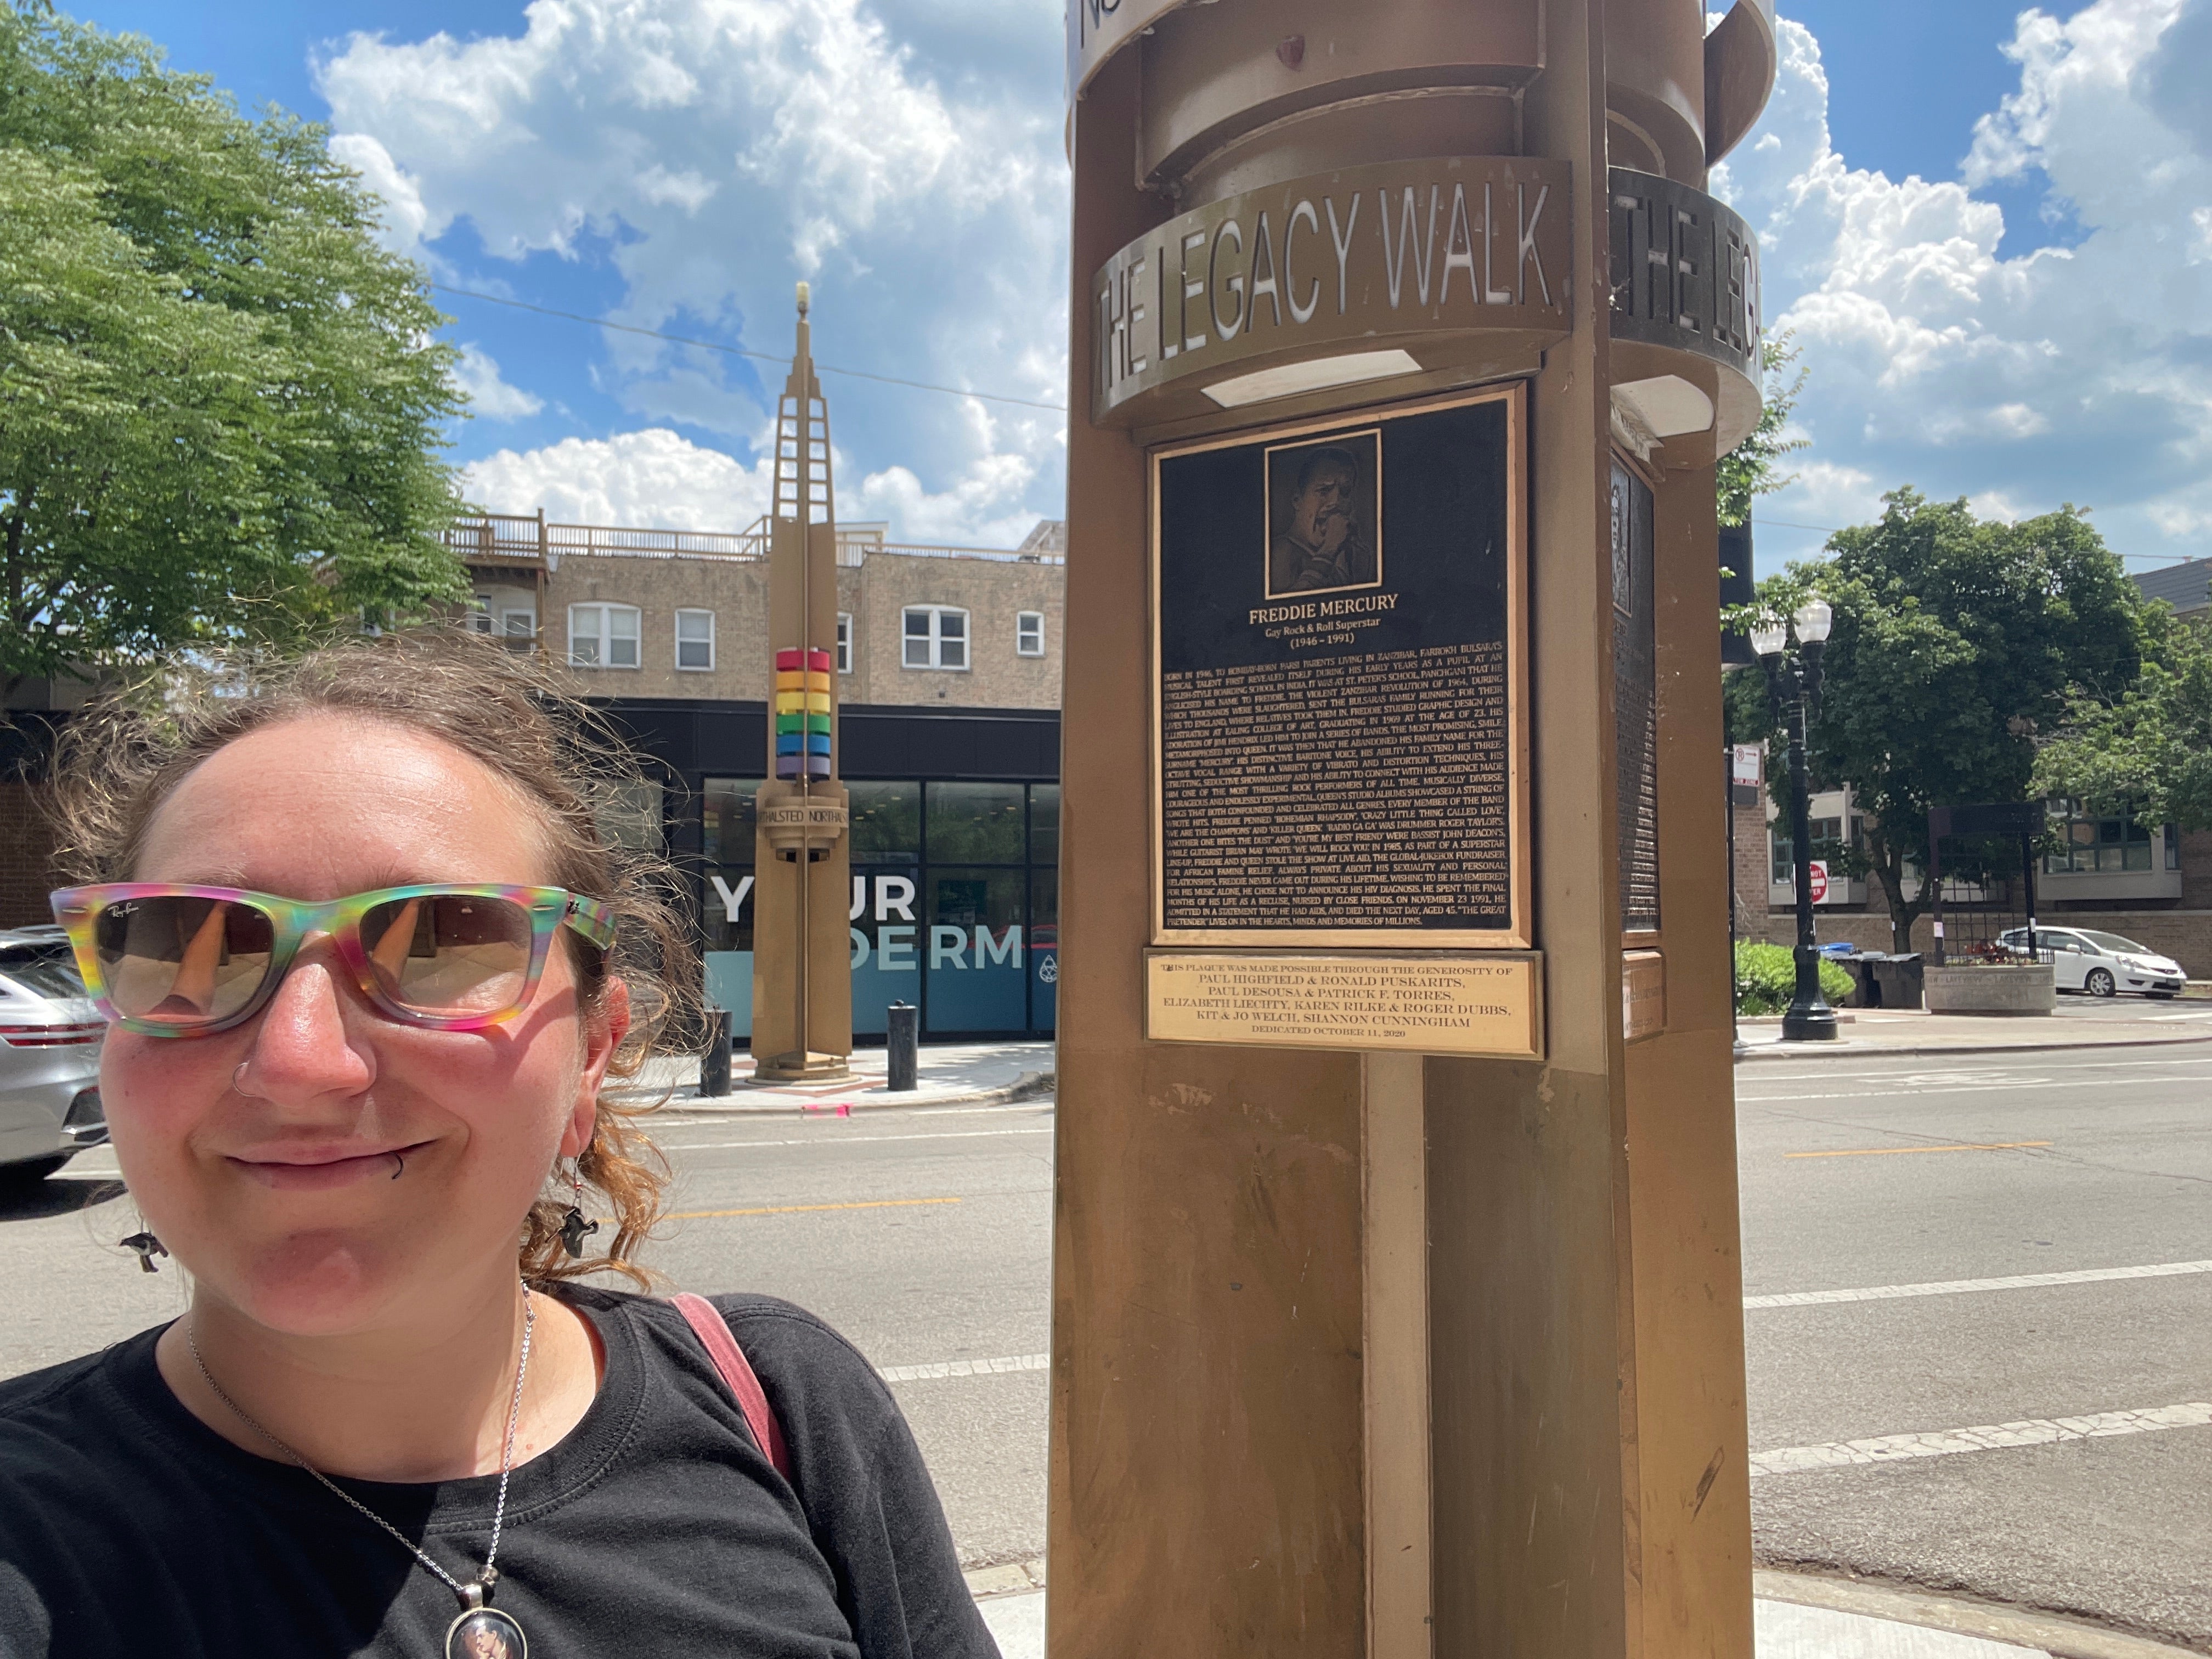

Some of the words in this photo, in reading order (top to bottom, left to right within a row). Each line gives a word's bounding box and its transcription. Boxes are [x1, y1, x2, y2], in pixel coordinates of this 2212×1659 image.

[1615, 195, 1700, 334] THE
[1098, 257, 1147, 394] THE
[1159, 190, 1359, 360] LEGACY
[1379, 180, 1553, 309] WALK
[1249, 603, 1316, 624] FREDDIE
[1321, 593, 1398, 617] MERCURY
[1265, 628, 1282, 639] Gay
[1284, 624, 1305, 635] Rock
[1307, 624, 1314, 633] &
[1317, 622, 1334, 632] Roll
[1336, 618, 1381, 630] Superstar
[1290, 636, 1317, 650] (1946
[1327, 632, 1355, 645] 1991)
[1345, 864, 1371, 872] ABOUT
[1440, 862, 1458, 871] AND
[1464, 884, 1480, 892] THE
[1396, 895, 1407, 904] ON
[1411, 895, 1453, 903] NOVEMBER
[1457, 895, 1466, 903] 23
[1494, 894, 1505, 902] HE
[1417, 967, 1493, 975] GENEROSITY
[1199, 974, 1231, 984] PAUL
[1233, 975, 1304, 984] HIGHFIELD
[1307, 976, 1317, 985] &
[1321, 976, 1376, 986] RONALD
[1381, 977, 1465, 988] PUSKARITS,
[1209, 986, 1239, 996] PAUL
[1243, 987, 1301, 997] DESOUSA
[1305, 988, 1314, 997] &
[1318, 988, 1375, 998] PATRICK
[1380, 990, 1389, 999] F.
[1393, 990, 1455, 1001] TORRES,
[1164, 997, 1230, 1008] ELIZABETH
[1233, 999, 1290, 1011] LIECHTY,
[1294, 1000, 1339, 1011] KAREN
[1344, 1001, 1386, 1012] RILKE
[1389, 1003, 1399, 1013] &
[1403, 1003, 1454, 1014] ROGER
[1457, 1004, 1511, 1017] DUBBS,
[1197, 1010, 1218, 1020] KIT
[1221, 1012, 1231, 1020] &
[1233, 1011, 1249, 1020] JO
[1251, 1012, 1300, 1023] WELCH,
[1303, 1013, 1368, 1024] SHANNON
[1372, 1015, 1471, 1028] CUNNINGHAM
[1251, 1025, 1311, 1034] DEDICATED
[1313, 1027, 1364, 1036] OCTOBER
